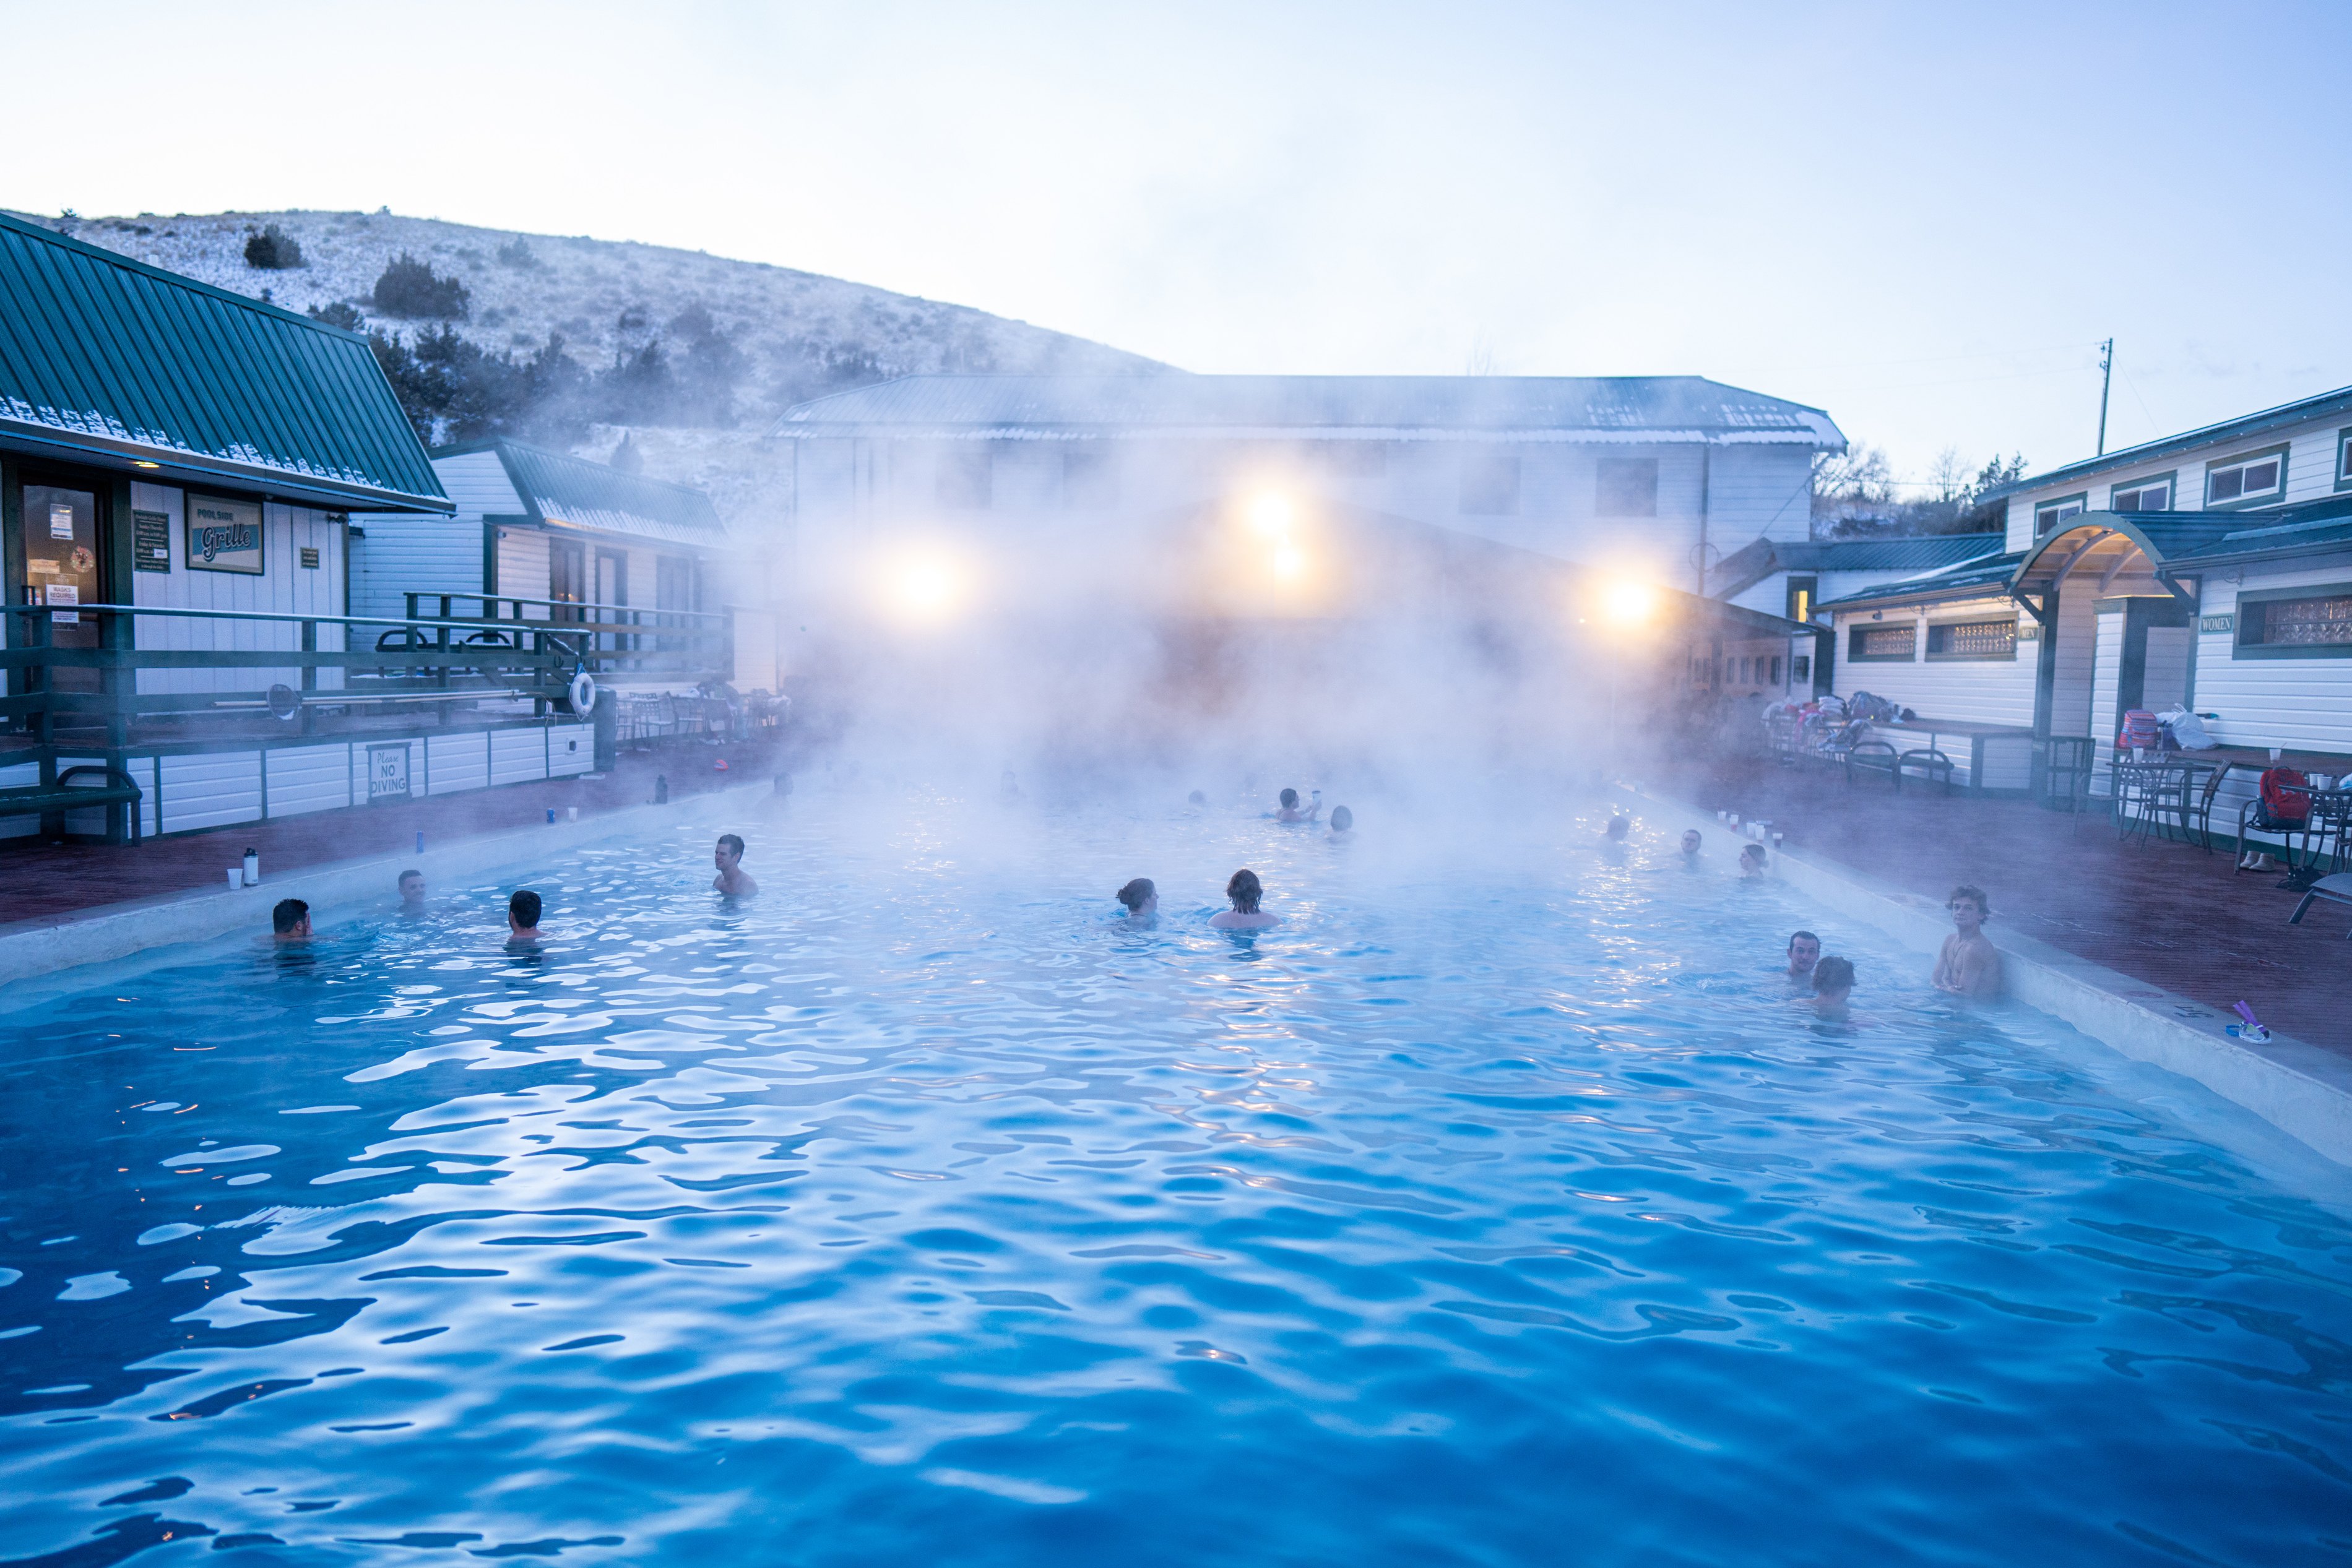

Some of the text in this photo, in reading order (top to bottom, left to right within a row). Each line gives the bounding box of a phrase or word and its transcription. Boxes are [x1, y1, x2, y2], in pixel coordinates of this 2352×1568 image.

[197, 509, 234, 521] POOL SIDE
[202, 523, 251, 562] Grille
[2202, 617, 2231, 631] WOMEN
[2021, 628, 2035, 639] MEN
[378, 752, 399, 764] Please
[381, 765, 396, 778] NO
[371, 778, 405, 793] DIVING
